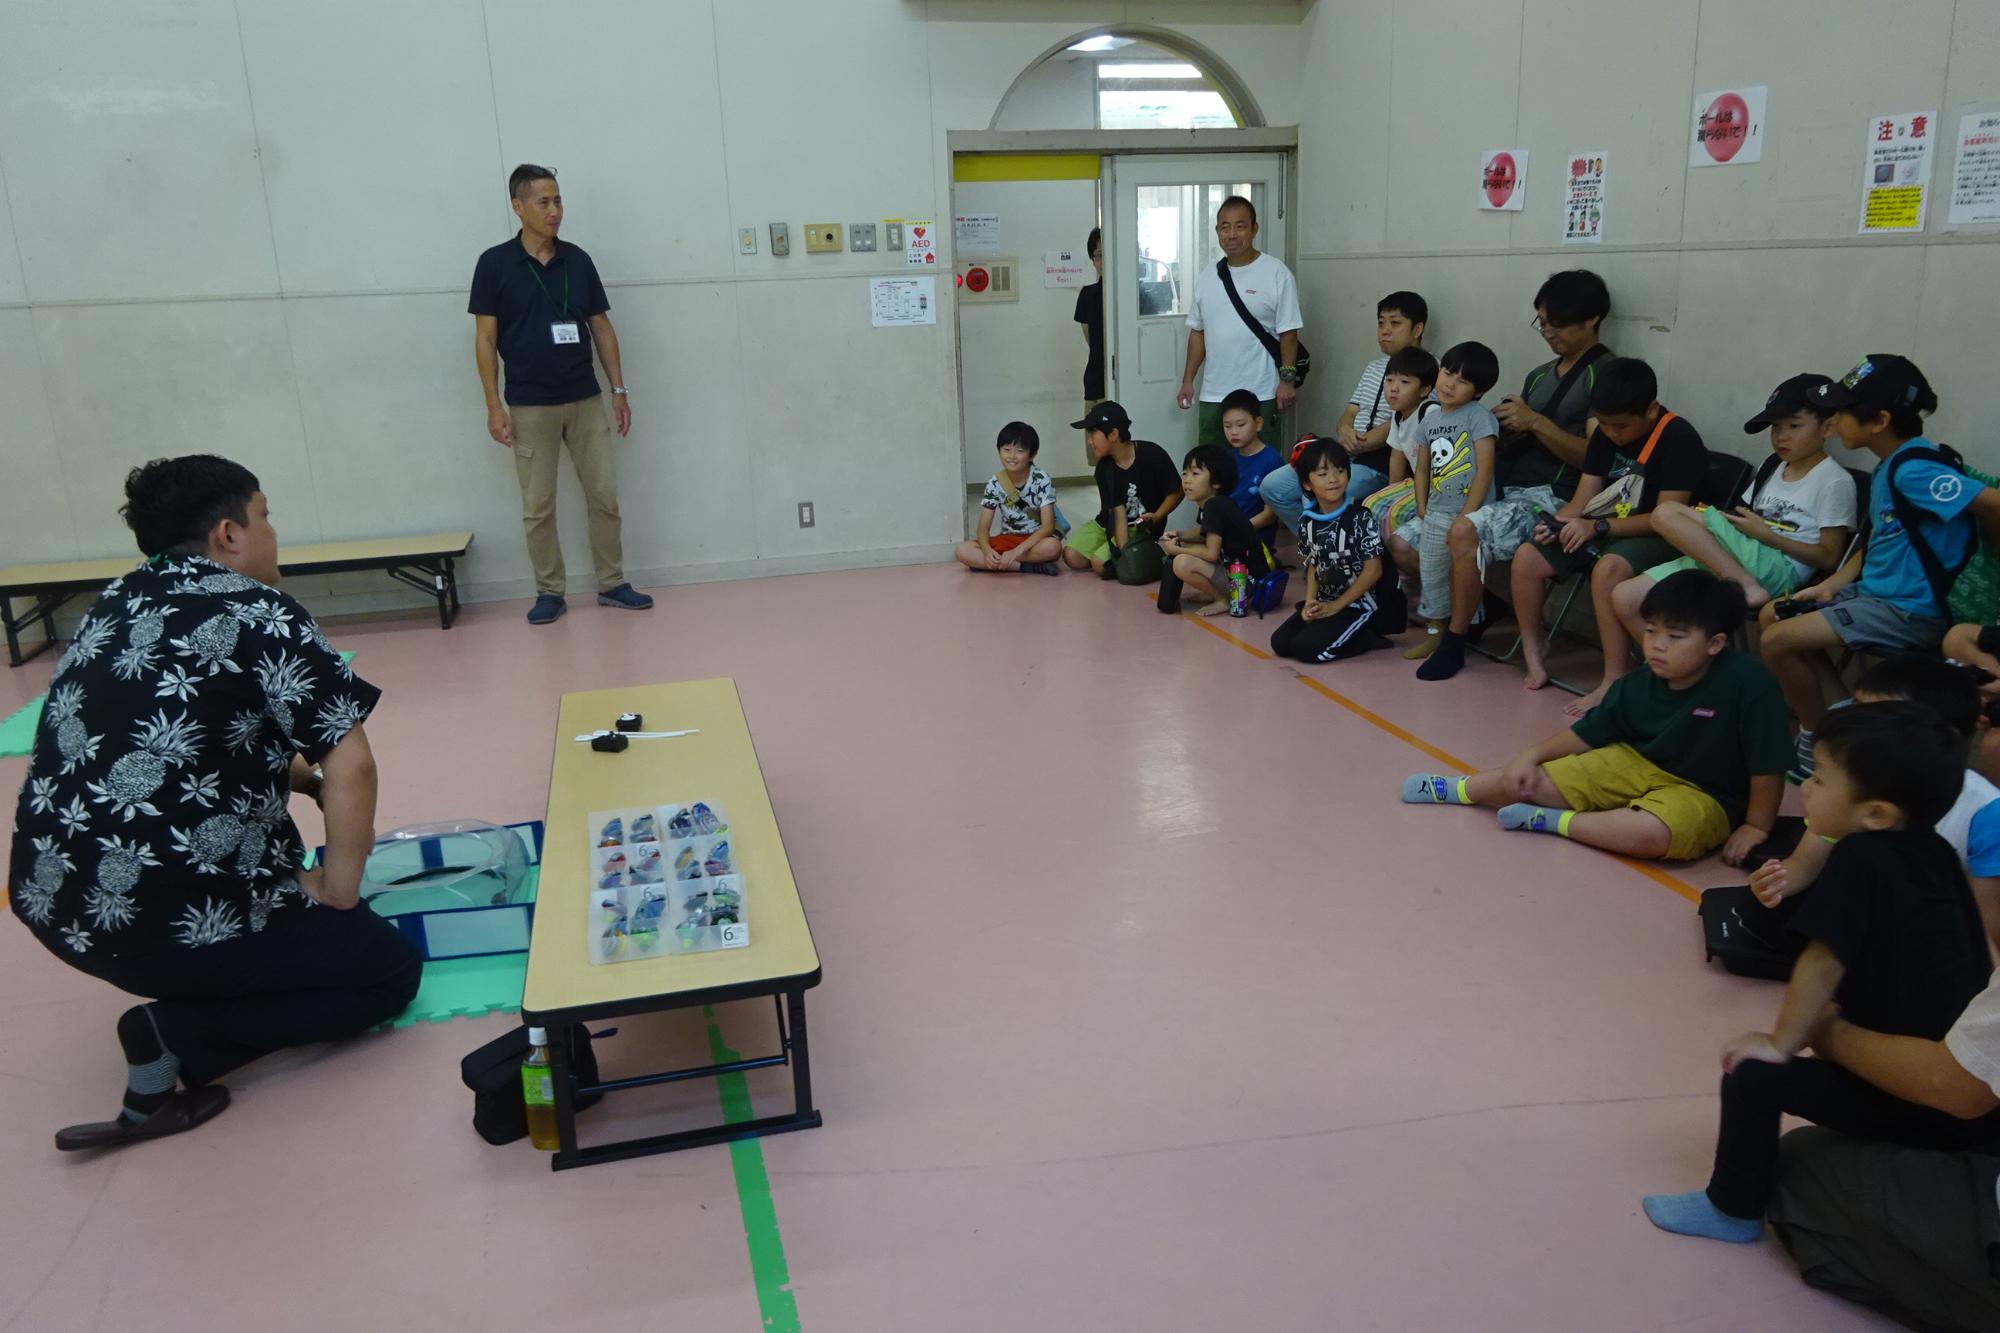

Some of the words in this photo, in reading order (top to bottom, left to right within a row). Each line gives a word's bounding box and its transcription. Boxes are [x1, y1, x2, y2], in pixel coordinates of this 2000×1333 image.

[911, 239, 931, 249] AED
[639, 844, 647, 857] 6
[643, 886, 652, 898] 6
[723, 926, 734, 942] 6
